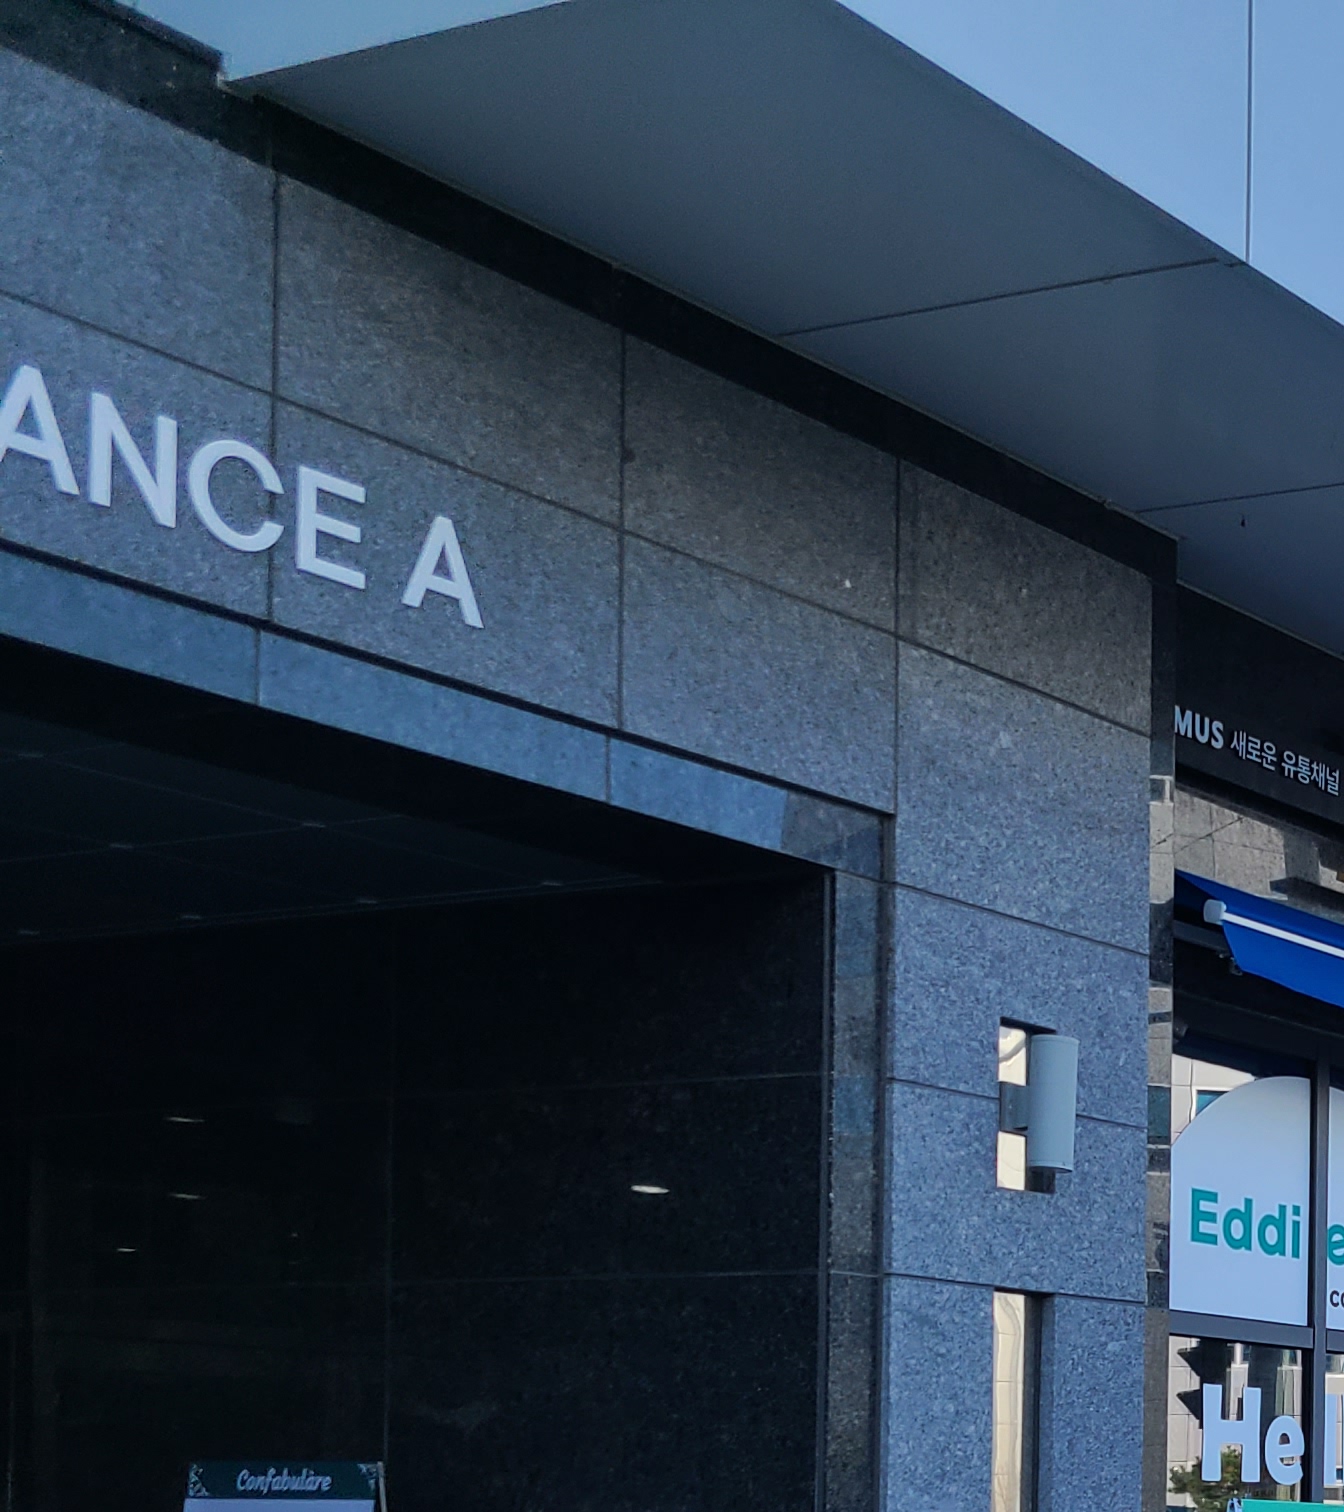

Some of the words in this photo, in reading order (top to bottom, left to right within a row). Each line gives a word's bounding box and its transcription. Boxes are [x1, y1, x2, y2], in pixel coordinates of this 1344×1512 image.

[0, 365, 366, 590] ANCE
[401, 515, 485, 628] A
[1175, 705, 1224, 749] MUS
[1230, 730, 1277, 771] 새로운
[1281, 750, 1339, 796] 유통채널
